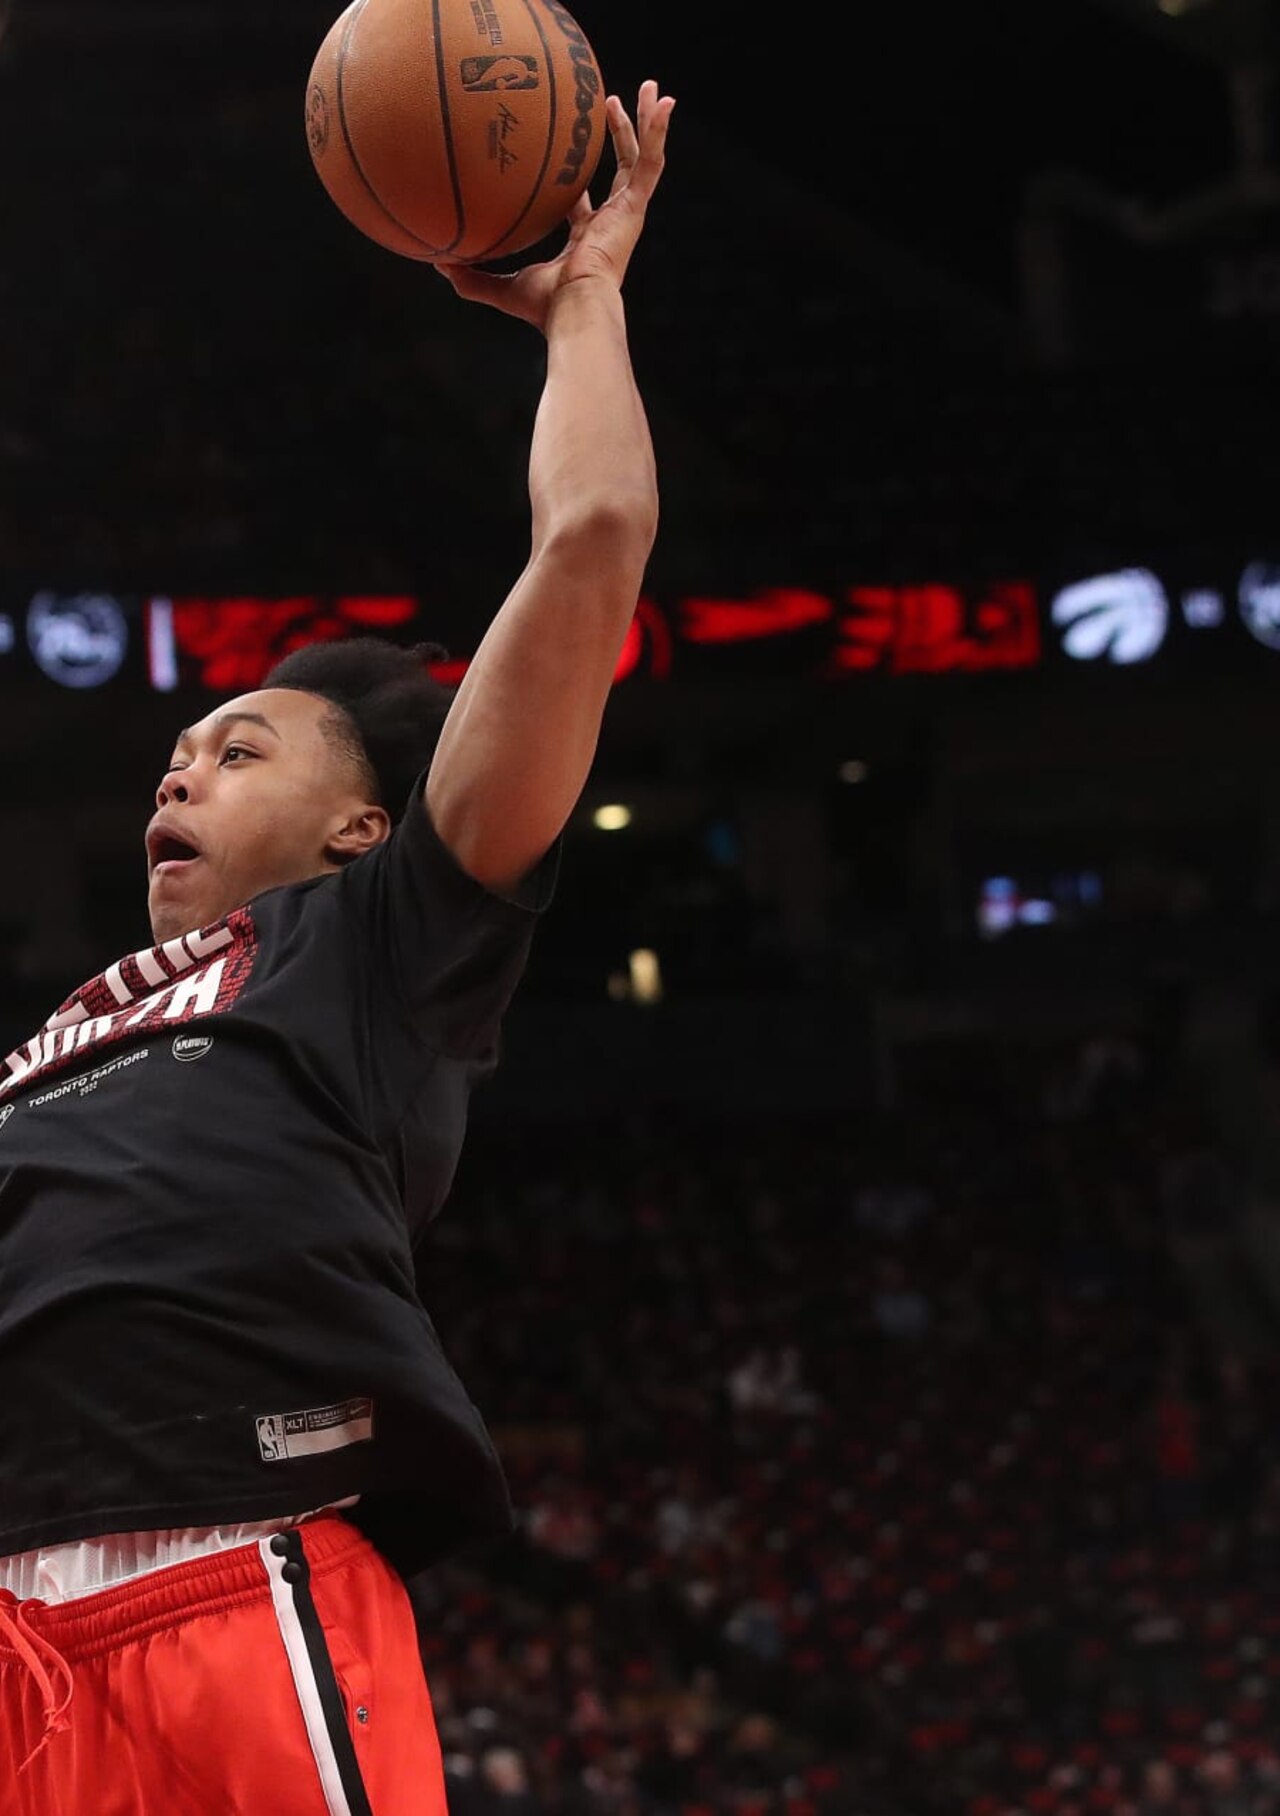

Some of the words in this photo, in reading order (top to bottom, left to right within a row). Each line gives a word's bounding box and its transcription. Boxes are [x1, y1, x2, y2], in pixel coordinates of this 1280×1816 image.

[28, 1077, 88, 1108] TORONTO
[90, 1049, 149, 1081] RAPTORS
[286, 1417, 304, 1430] XLT
